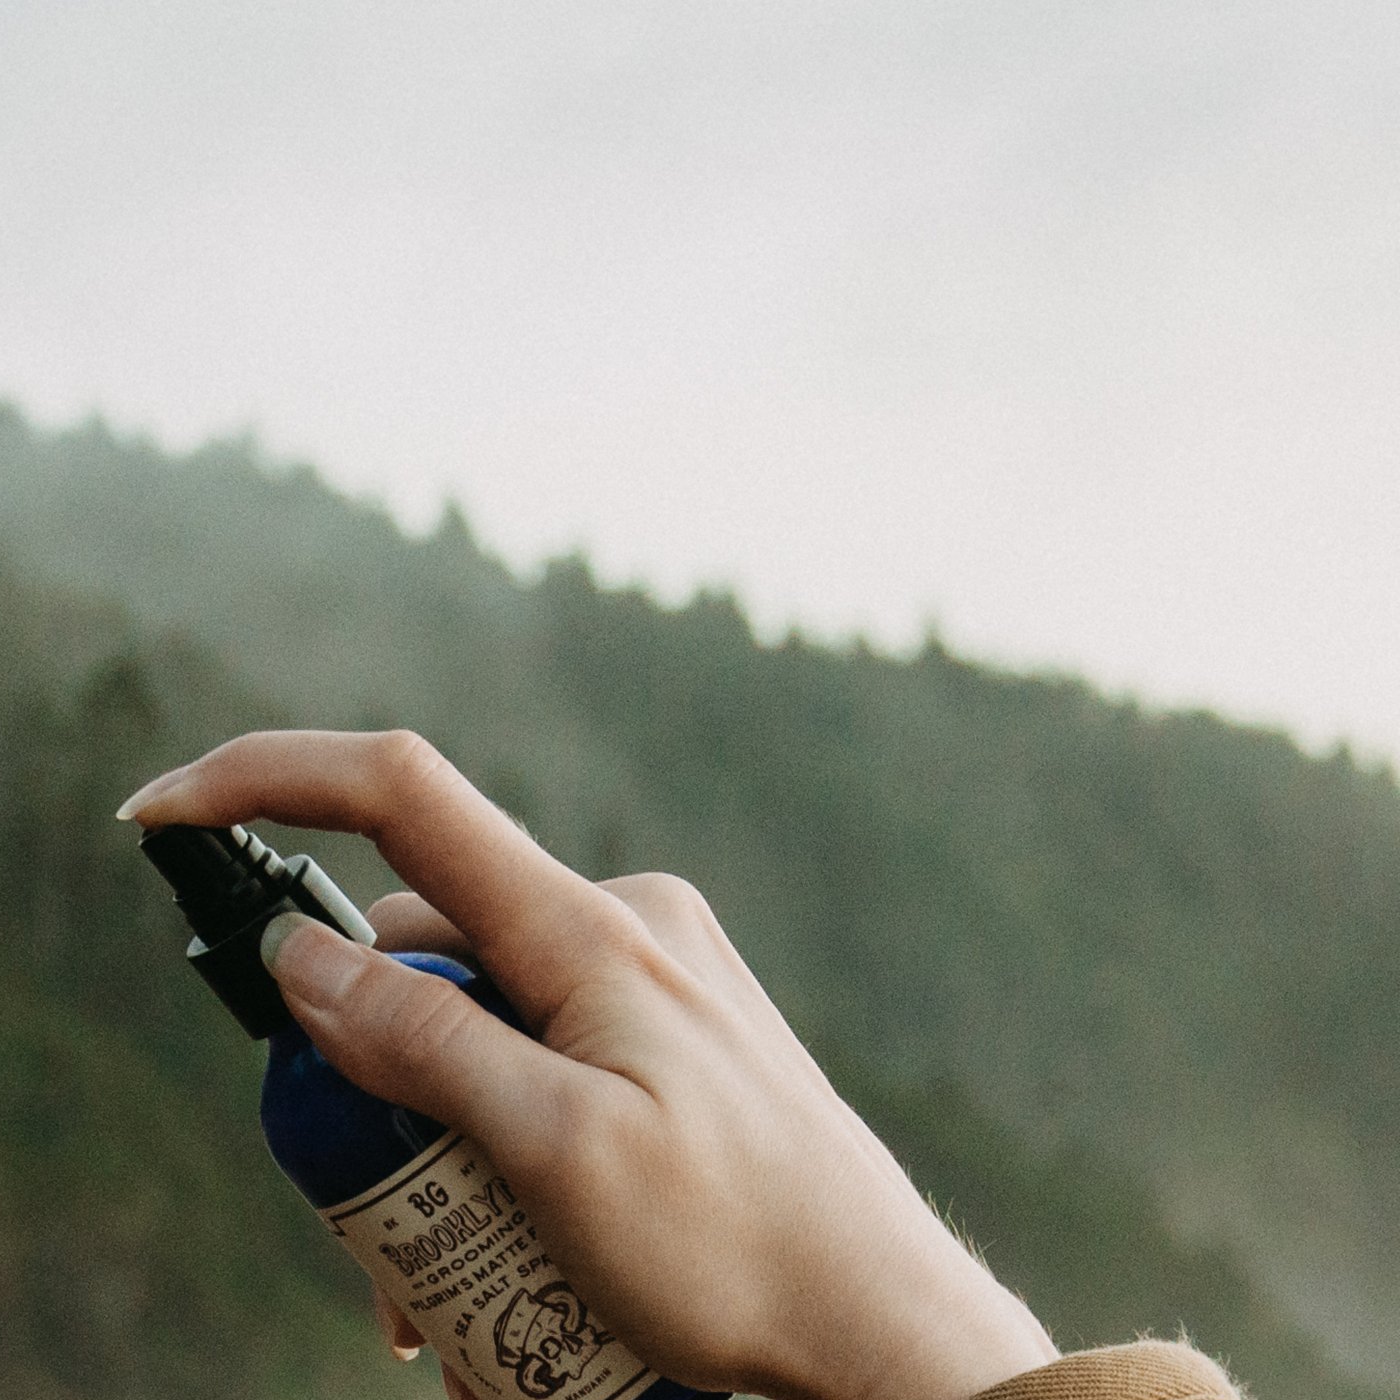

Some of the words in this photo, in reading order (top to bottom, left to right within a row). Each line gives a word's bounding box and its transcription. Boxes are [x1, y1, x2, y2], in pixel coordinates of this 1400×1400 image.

[408, 1181, 449, 1218] BG
[409, 1277, 473, 1313] PILGRIM'S
[472, 1236, 529, 1282] MATTE
[426, 1210, 526, 1285] GROOMING
[454, 1311, 475, 1339] SEA
[472, 1275, 511, 1310] SALT
[516, 1253, 553, 1278] SPR
